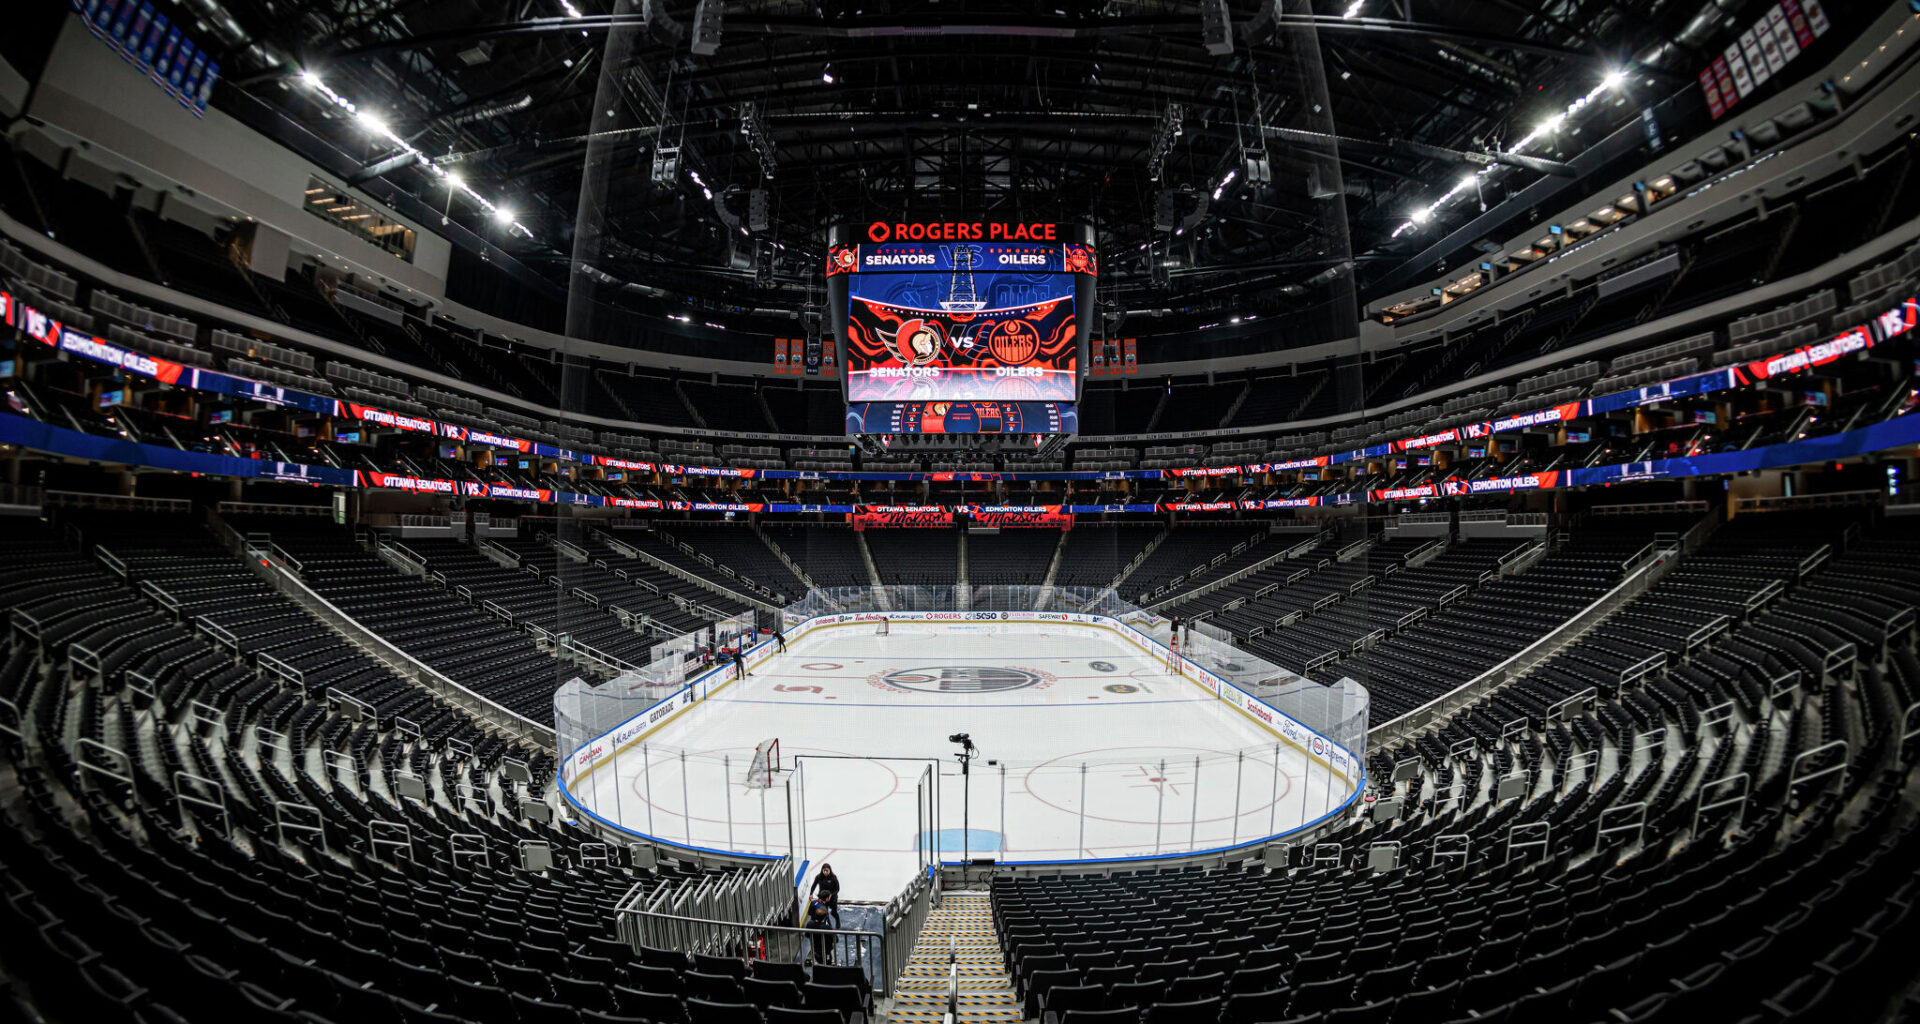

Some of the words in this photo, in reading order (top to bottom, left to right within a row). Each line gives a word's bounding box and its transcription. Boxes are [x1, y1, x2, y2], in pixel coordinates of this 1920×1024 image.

[896, 223, 983, 240] ROGERS
[990, 223, 1056, 240] PLACE
[866, 255, 936, 266] SENATORS
[998, 254, 1046, 265] OILERS
[63, 331, 124, 365] EDMONTON
[951, 337, 974, 348] VS
[994, 334, 1034, 357] OILERS
[1767, 351, 1808, 376] OTTAWA
[1809, 332, 1865, 363] SENATORS
[1880, 308, 1904, 338] VS
[870, 367, 940, 377] SENATORS
[996, 366, 1044, 377] OILERS
[364, 409, 395, 424] OTTAWA
[396, 416, 431, 432] SENATORS
[446, 424, 459, 438] VS
[471, 432, 501, 445] EDMONTON
[502, 437, 520, 449] OILERS
[1405, 437, 1426, 449] OTTAWA
[1426, 431, 1455, 446] SENATORS
[1469, 424, 1481, 438] VS
[1495, 416, 1534, 432] EDMONTON
[1534, 410, 1561, 423] OILERS
[626, 462, 651, 470] SENATORS
[664, 465, 675, 473] VS
[688, 467, 720, 475] EDMONTON
[1208, 467, 1237, 475] SENATORS
[1250, 465, 1261, 473] VS
[1274, 461, 1300, 470] EDMONTON
[1301, 459, 1318, 468] OILERS
[384, 476, 416, 489] OTTAWA
[416, 478, 452, 492] SENATORS
[467, 482, 479, 495] VS
[492, 487, 522, 498] EDMONTON
[523, 489, 540, 499] OILERS
[1383, 489, 1405, 498] OTTAWA
[1405, 486, 1432, 497] SENATORS
[1446, 482, 1458, 495] VS
[1472, 478, 1513, 491] EDMONTON
[1513, 476, 1539, 488] OILERS
[615, 499, 635, 507] OTTAWA
[672, 502, 682, 510] VS
[957, 505, 969, 513] VS
[1202, 502, 1231, 510] SENATORS
[1244, 501, 1255, 510] VS
[1267, 500, 1294, 508] EDMONTON
[1294, 499, 1310, 507] OILERS
[650, 701, 674, 723] GATORADE
[1247, 699, 1273, 723] Scotiabank
[1283, 719, 1298, 740] Ford
[1325, 744, 1347, 768] Supreme
